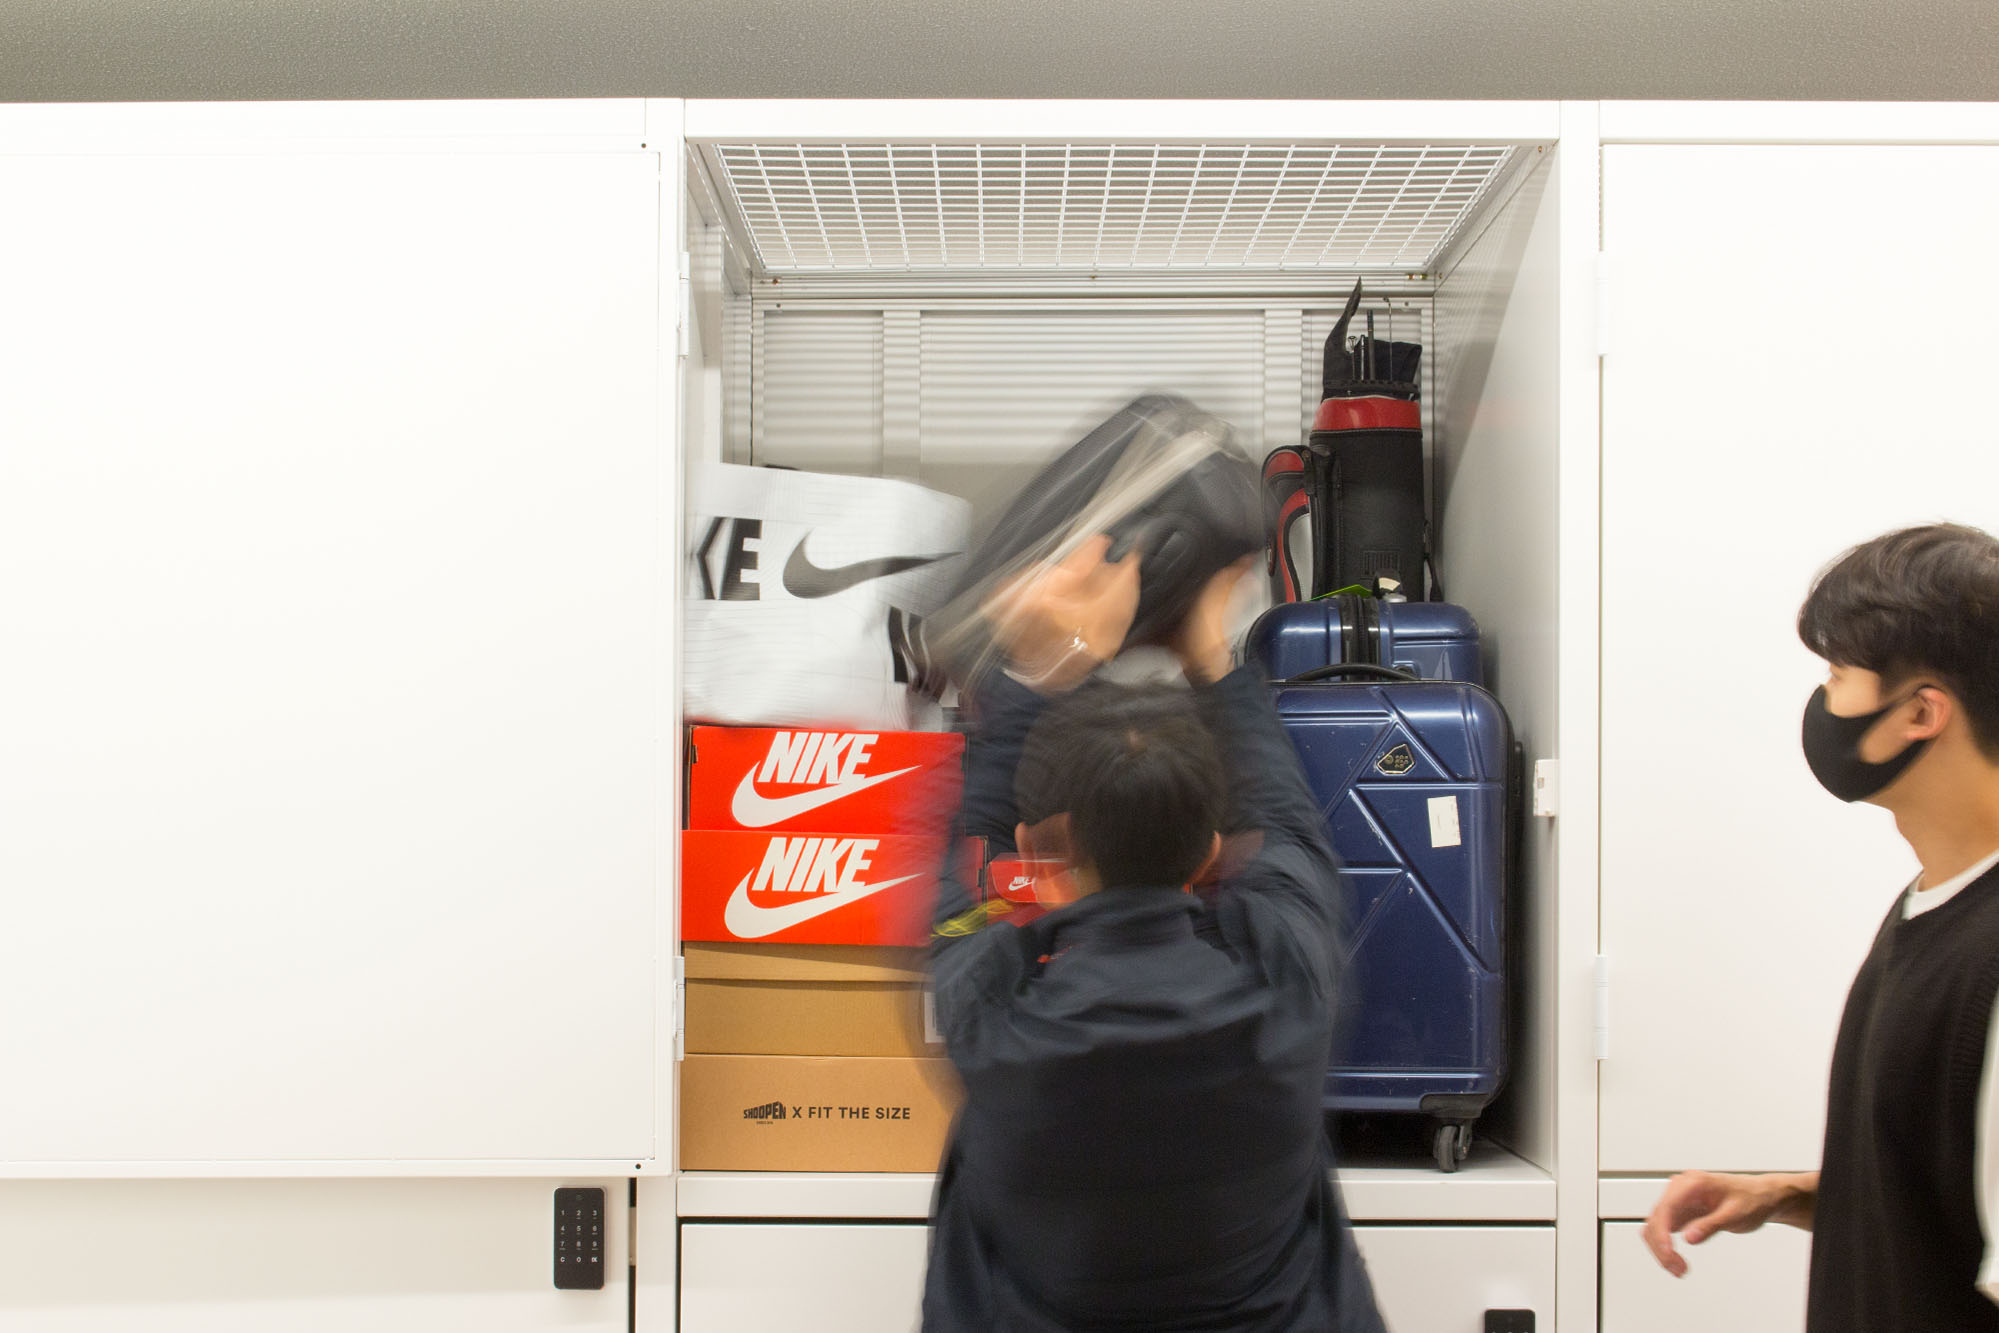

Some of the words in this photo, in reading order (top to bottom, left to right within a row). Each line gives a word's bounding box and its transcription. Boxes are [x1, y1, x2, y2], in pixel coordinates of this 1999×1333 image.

[757, 731, 880, 785] NIKE
[751, 836, 881, 894] NIKE
[743, 1101, 787, 1120] SHOOPEN
[792, 1106, 802, 1119] X
[808, 1106, 833, 1119] FIT
[838, 1106, 870, 1119] THE
[875, 1107, 911, 1120] SIZE
